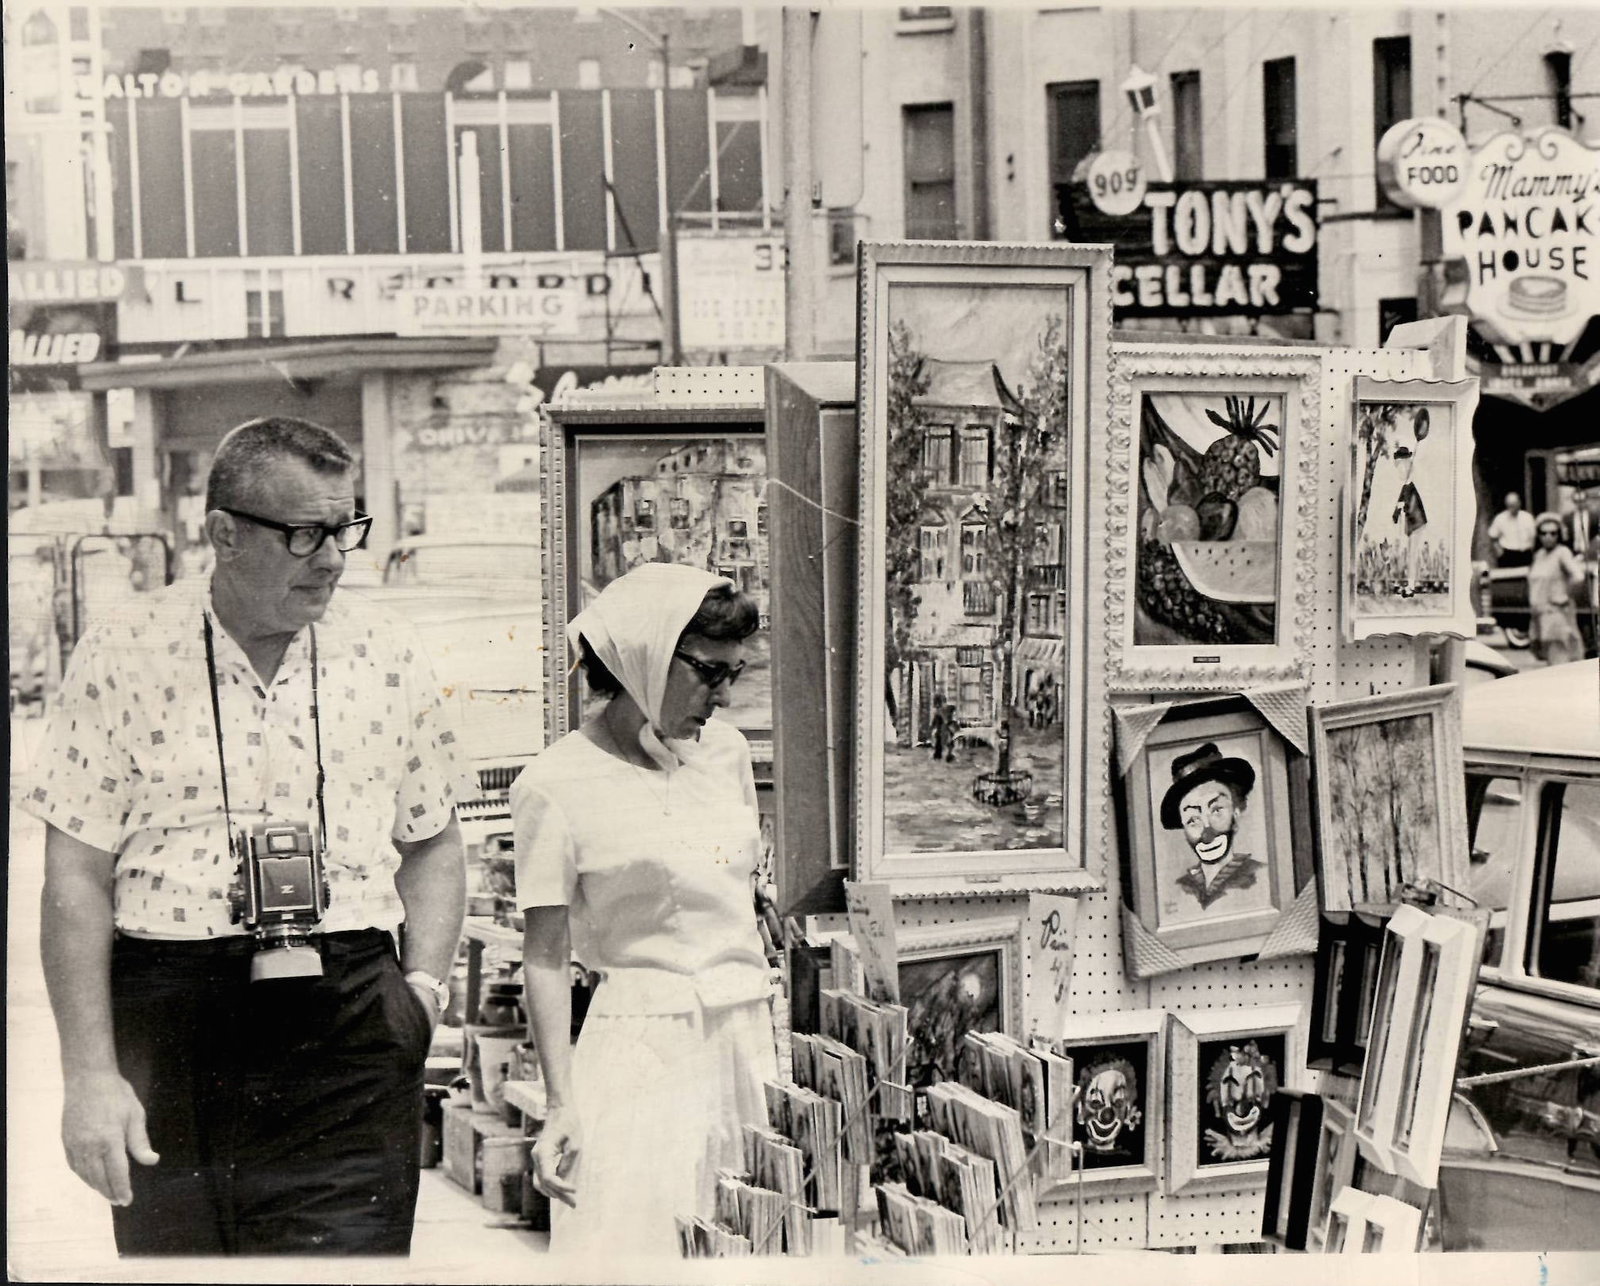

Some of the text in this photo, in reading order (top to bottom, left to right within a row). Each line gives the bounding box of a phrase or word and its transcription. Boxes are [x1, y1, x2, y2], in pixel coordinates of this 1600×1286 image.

[1407, 165, 1459, 186] FOOD
[1144, 183, 1316, 255] TONY'S
[1112, 264, 1281, 307] CELLAR
[1478, 246, 1589, 286] HOUSE
[413, 294, 563, 317] PARKING
